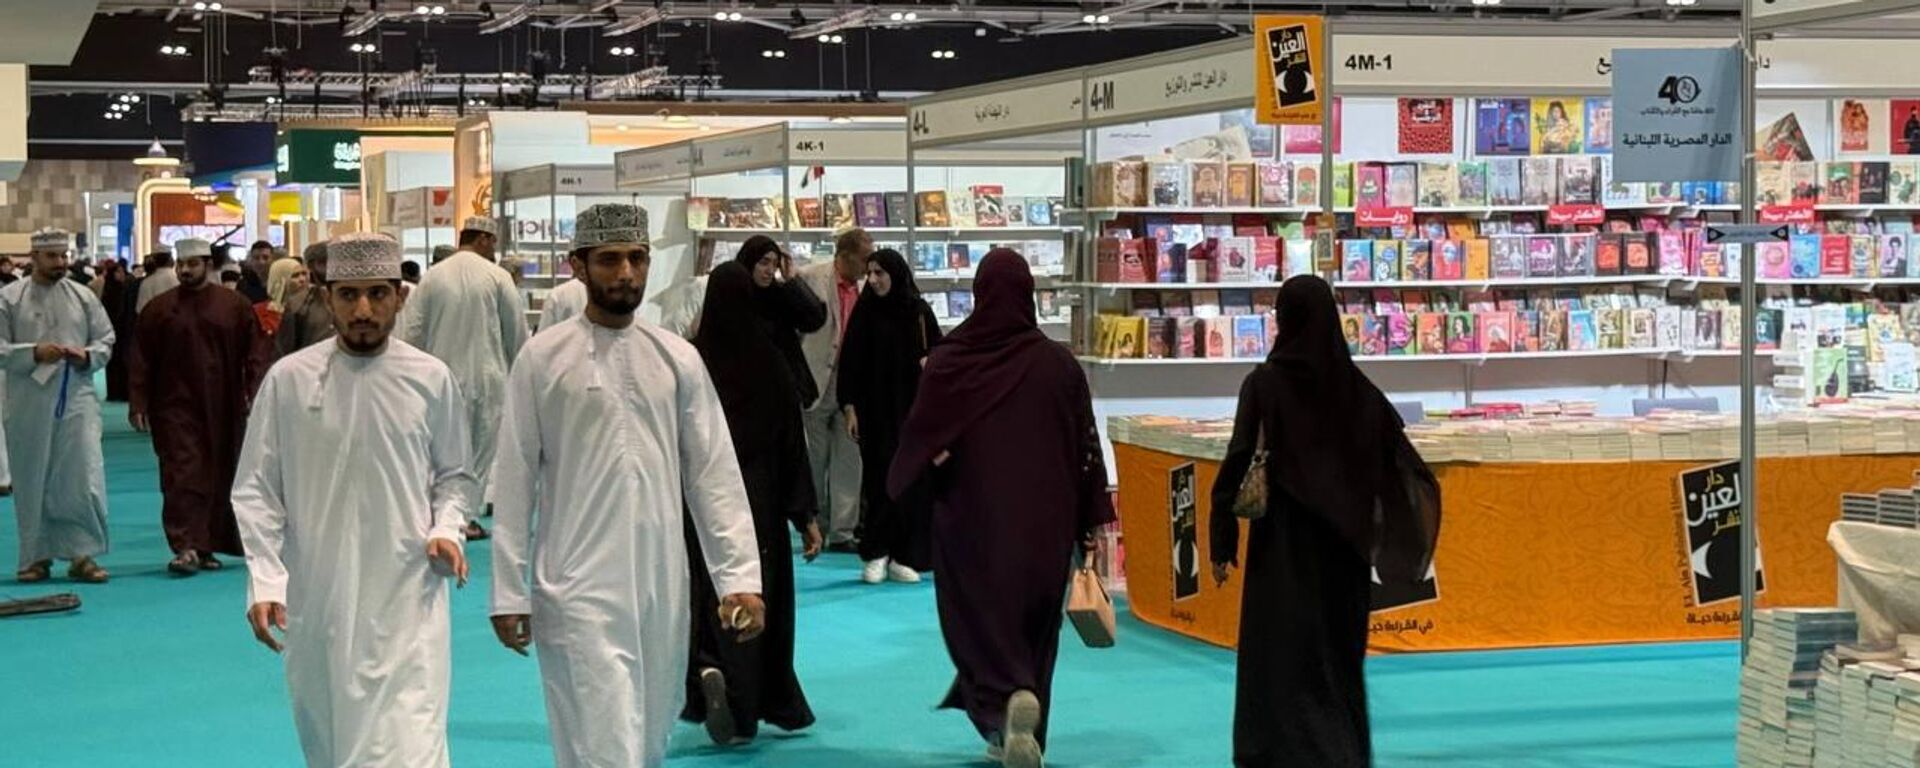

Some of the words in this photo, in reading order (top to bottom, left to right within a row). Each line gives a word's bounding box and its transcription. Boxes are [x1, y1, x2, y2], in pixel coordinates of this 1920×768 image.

[1272, 31, 1305, 62] العين
[1345, 54, 1392, 70] 4M-1
[1090, 81, 1114, 111] 4-M
[1658, 76, 1701, 104] 40
[913, 109, 929, 135] 4-L
[796, 141, 824, 151] 4K-1
[1623, 133, 1662, 148] اللبنانية
[1664, 133, 1708, 148] المصرية
[1709, 133, 1732, 148] الدار
[1704, 469, 1725, 492] دار
[1686, 472, 1741, 527] لعين
[1384, 619, 1418, 634] القراءة
[1419, 618, 1434, 635] في
